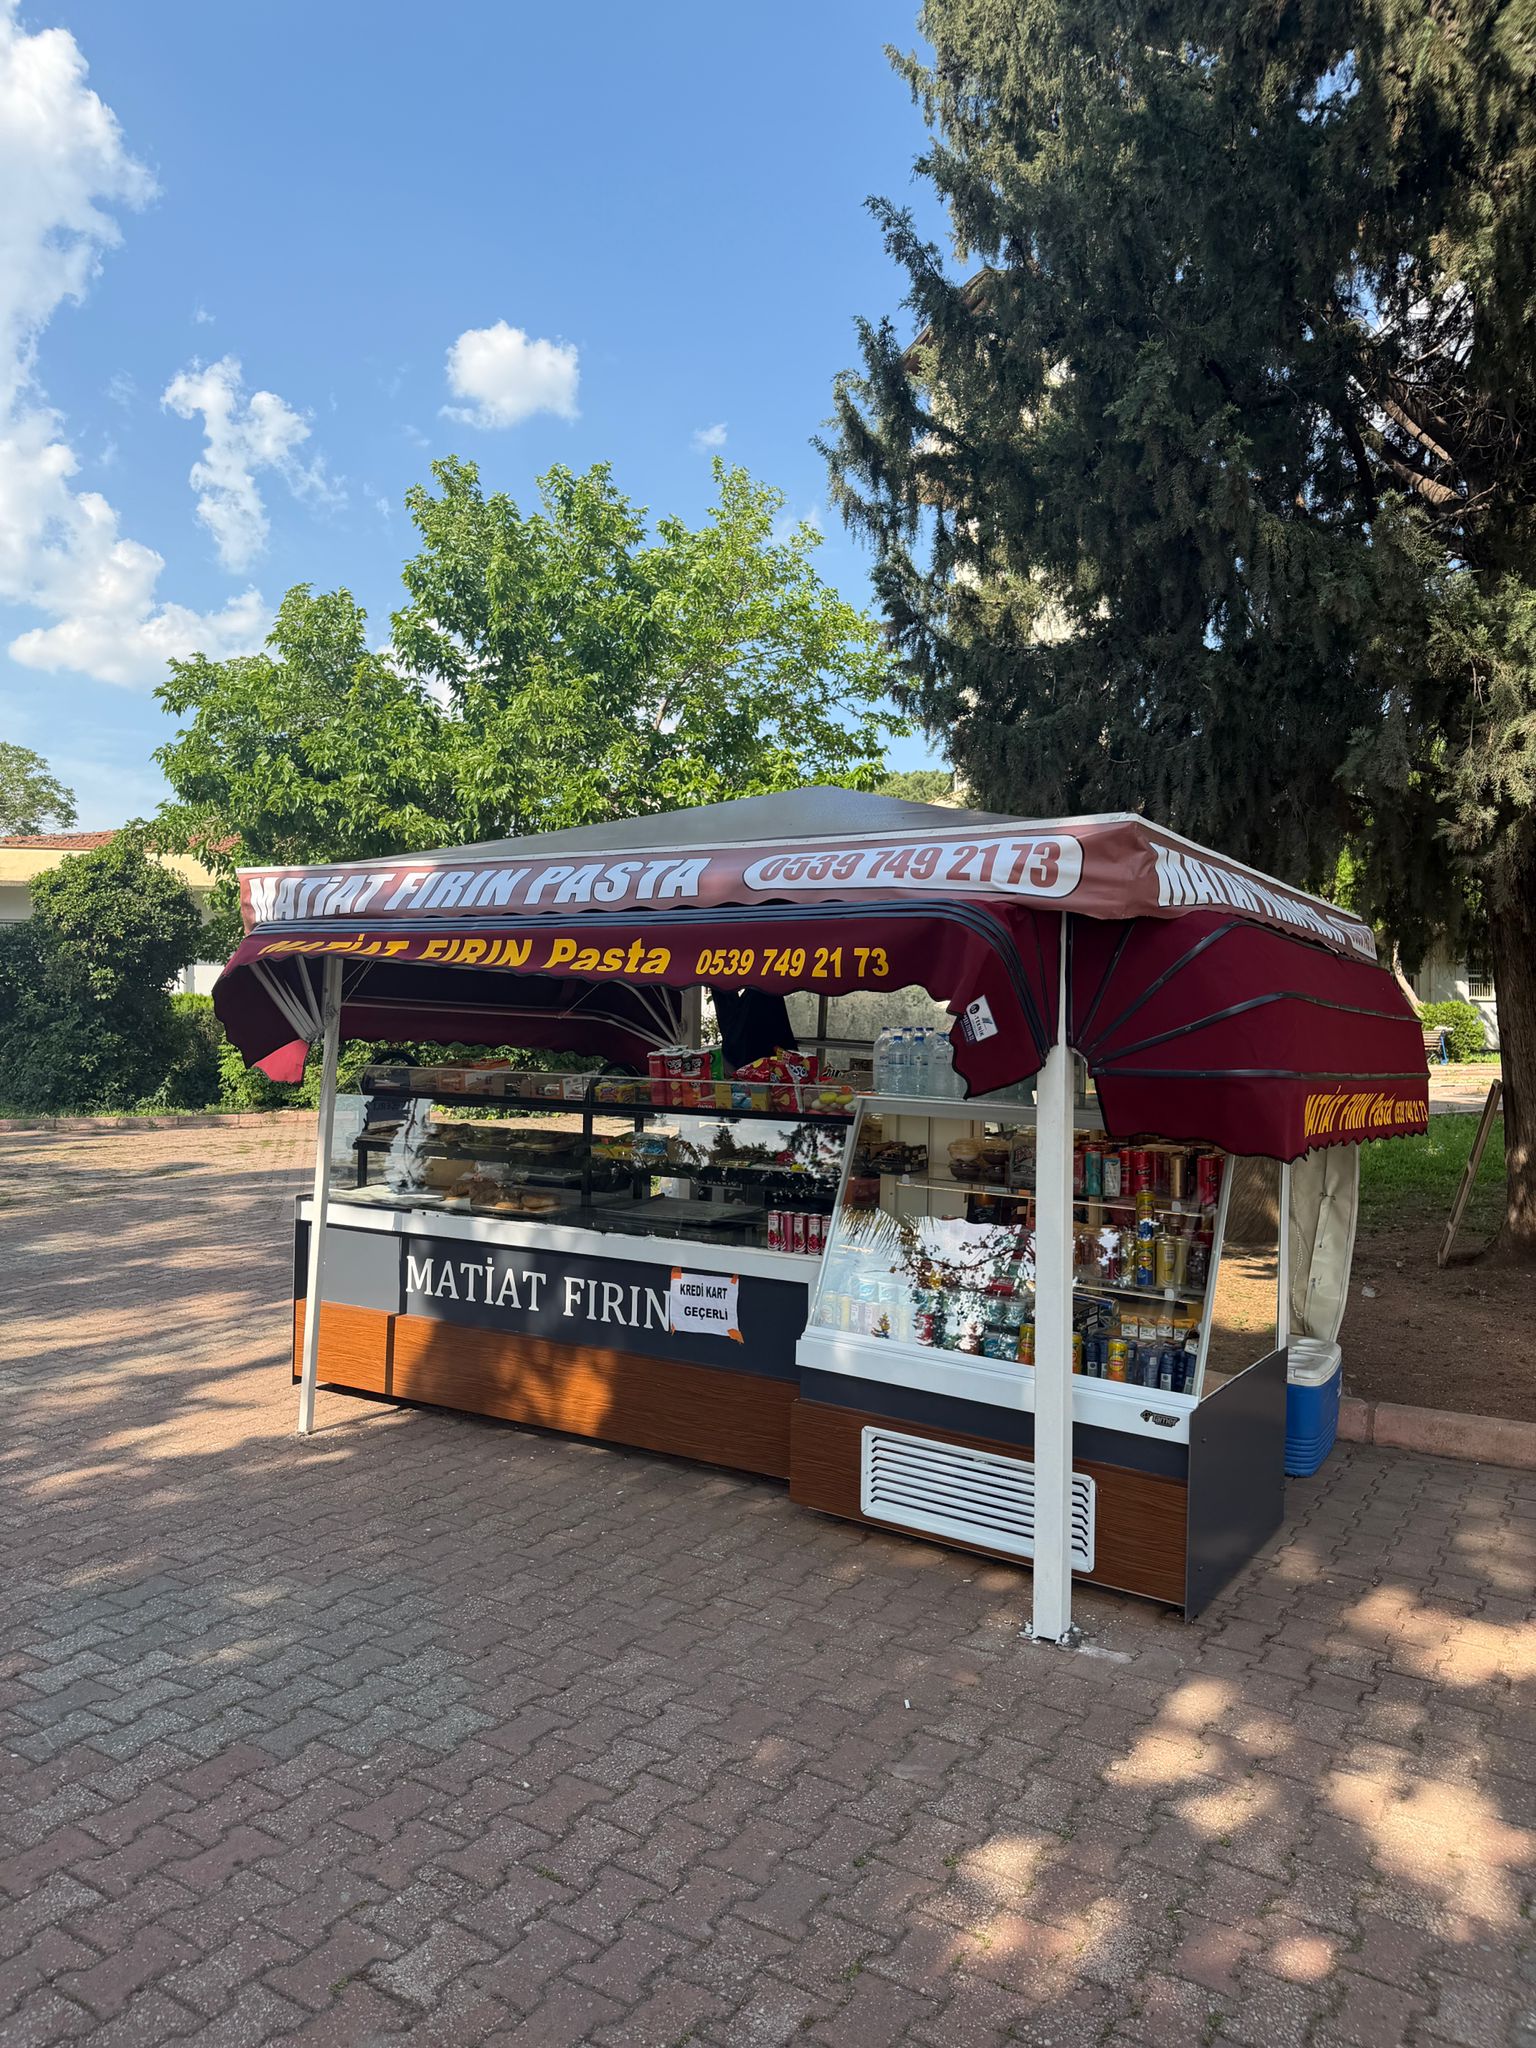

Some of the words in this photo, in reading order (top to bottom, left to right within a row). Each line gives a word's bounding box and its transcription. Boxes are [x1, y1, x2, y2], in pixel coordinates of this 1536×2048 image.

[759, 853, 865, 882] 0539
[866, 846, 944, 880] 749
[946, 844, 1001, 882] 21
[1006, 841, 1062, 888] 73
[383, 868, 533, 911] FIRIN
[523, 858, 712, 904] PASTA
[417, 939, 533, 967] FIRIN
[541, 938, 671, 974] Pasta
[695, 949, 755, 976] 0539
[761, 948, 806, 977] 749
[812, 947, 843, 977] 21
[854, 947, 889, 977] 73
[406, 1255, 546, 1311] MATİAT
[562, 1276, 671, 1332] FIRIN
[680, 1283, 704, 1297] KREDİ
[706, 1286, 727, 1300] KART
[684, 1306, 728, 1320] GEÇERLİ
